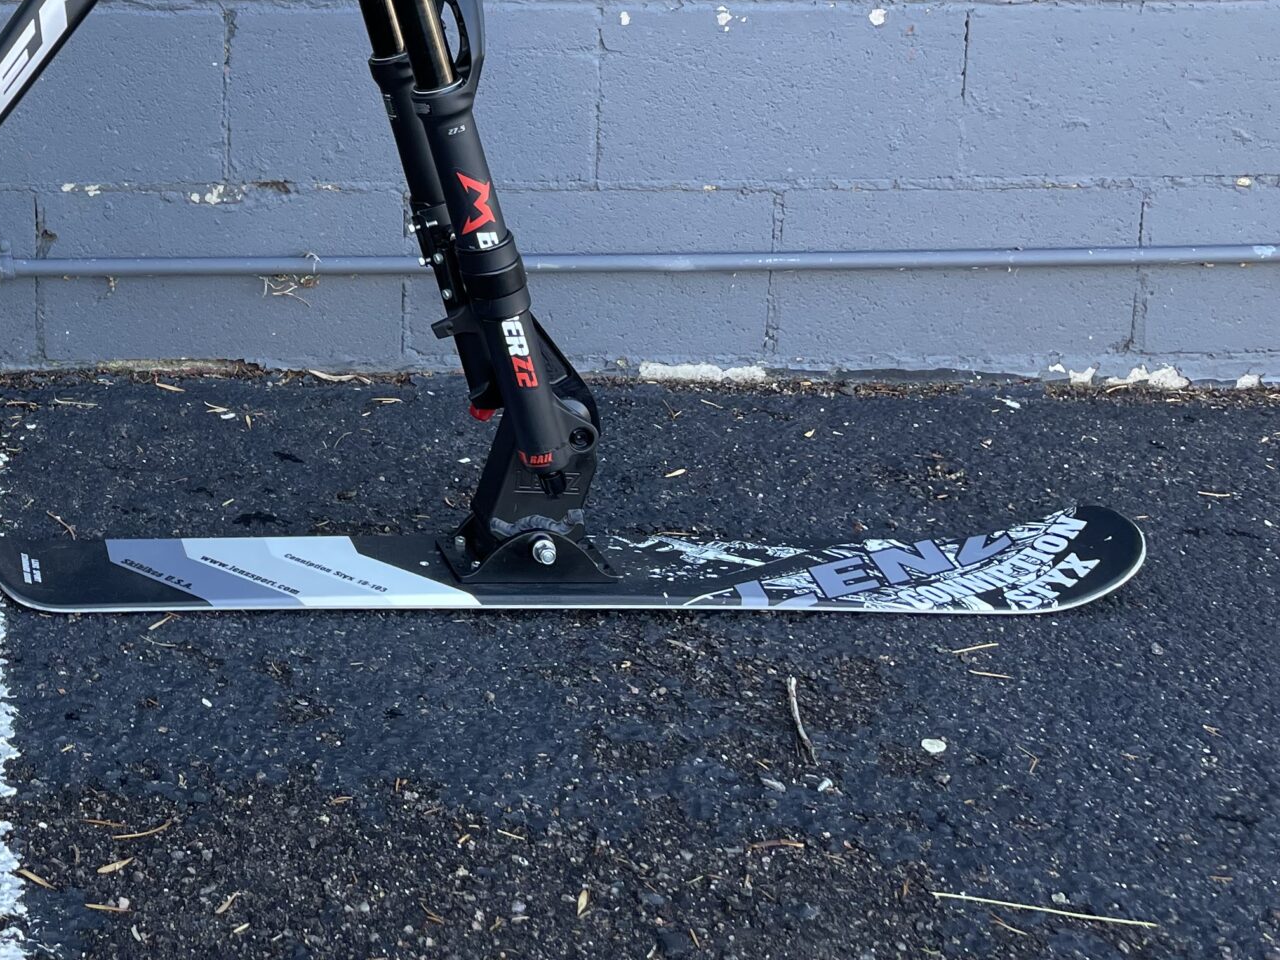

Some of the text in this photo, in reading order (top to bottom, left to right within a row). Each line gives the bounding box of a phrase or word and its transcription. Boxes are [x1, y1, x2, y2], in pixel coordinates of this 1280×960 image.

[200, 555, 300, 595] www.lenzsport.com
[284, 553, 332, 573] Conniption
[333, 570, 355, 582] Styx
[898, 514, 1088, 610] CONNIPTION
[1003, 552, 1101, 610] STYX
